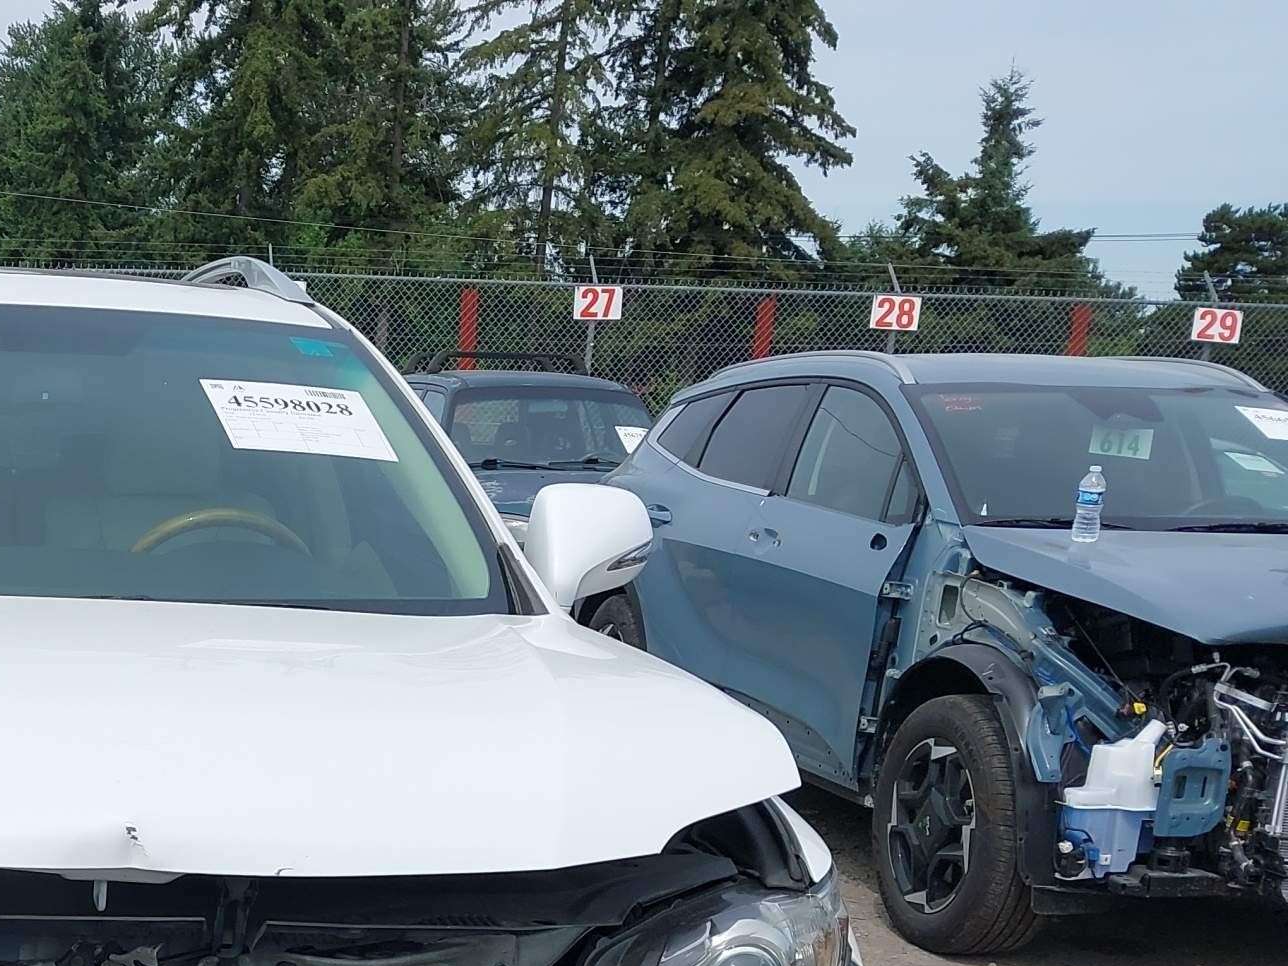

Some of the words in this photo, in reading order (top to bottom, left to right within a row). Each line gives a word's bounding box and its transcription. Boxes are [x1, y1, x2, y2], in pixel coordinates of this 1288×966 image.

[580, 288, 615, 317] 27
[875, 298, 915, 328] 28
[1197, 310, 1238, 341] 29
[227, 395, 353, 417] 45598028
[1100, 432, 1140, 456] 614
